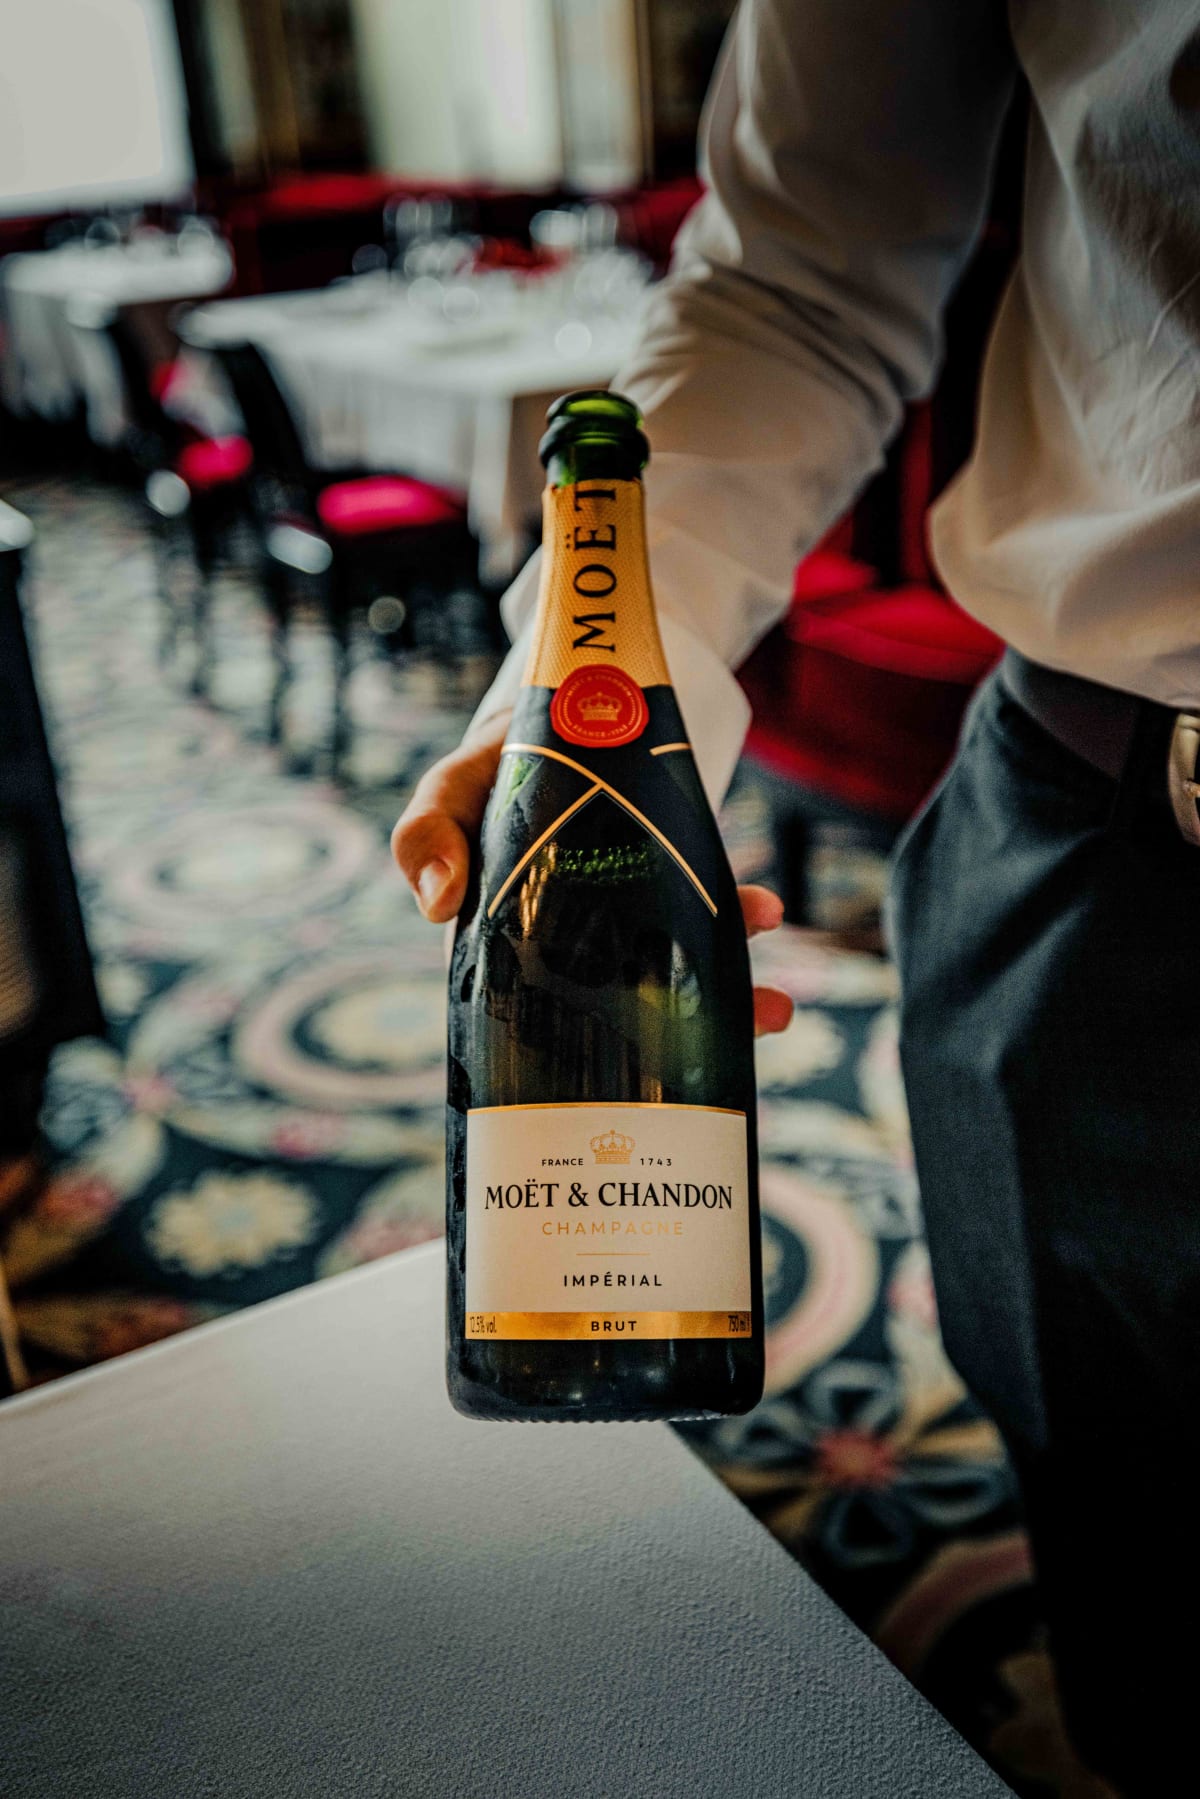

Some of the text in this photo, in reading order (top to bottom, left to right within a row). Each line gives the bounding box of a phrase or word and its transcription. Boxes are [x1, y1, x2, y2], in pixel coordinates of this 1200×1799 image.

[566, 481, 617, 653] MOËT
[541, 1158, 673, 1167] FRANCE 1743
[485, 1178, 733, 1209] MOËT & CHANDON
[541, 1221, 684, 1236] CHAMPAGNE
[563, 1270, 662, 1287] IMPÉRIAL
[590, 1320, 638, 1332] BRUT
